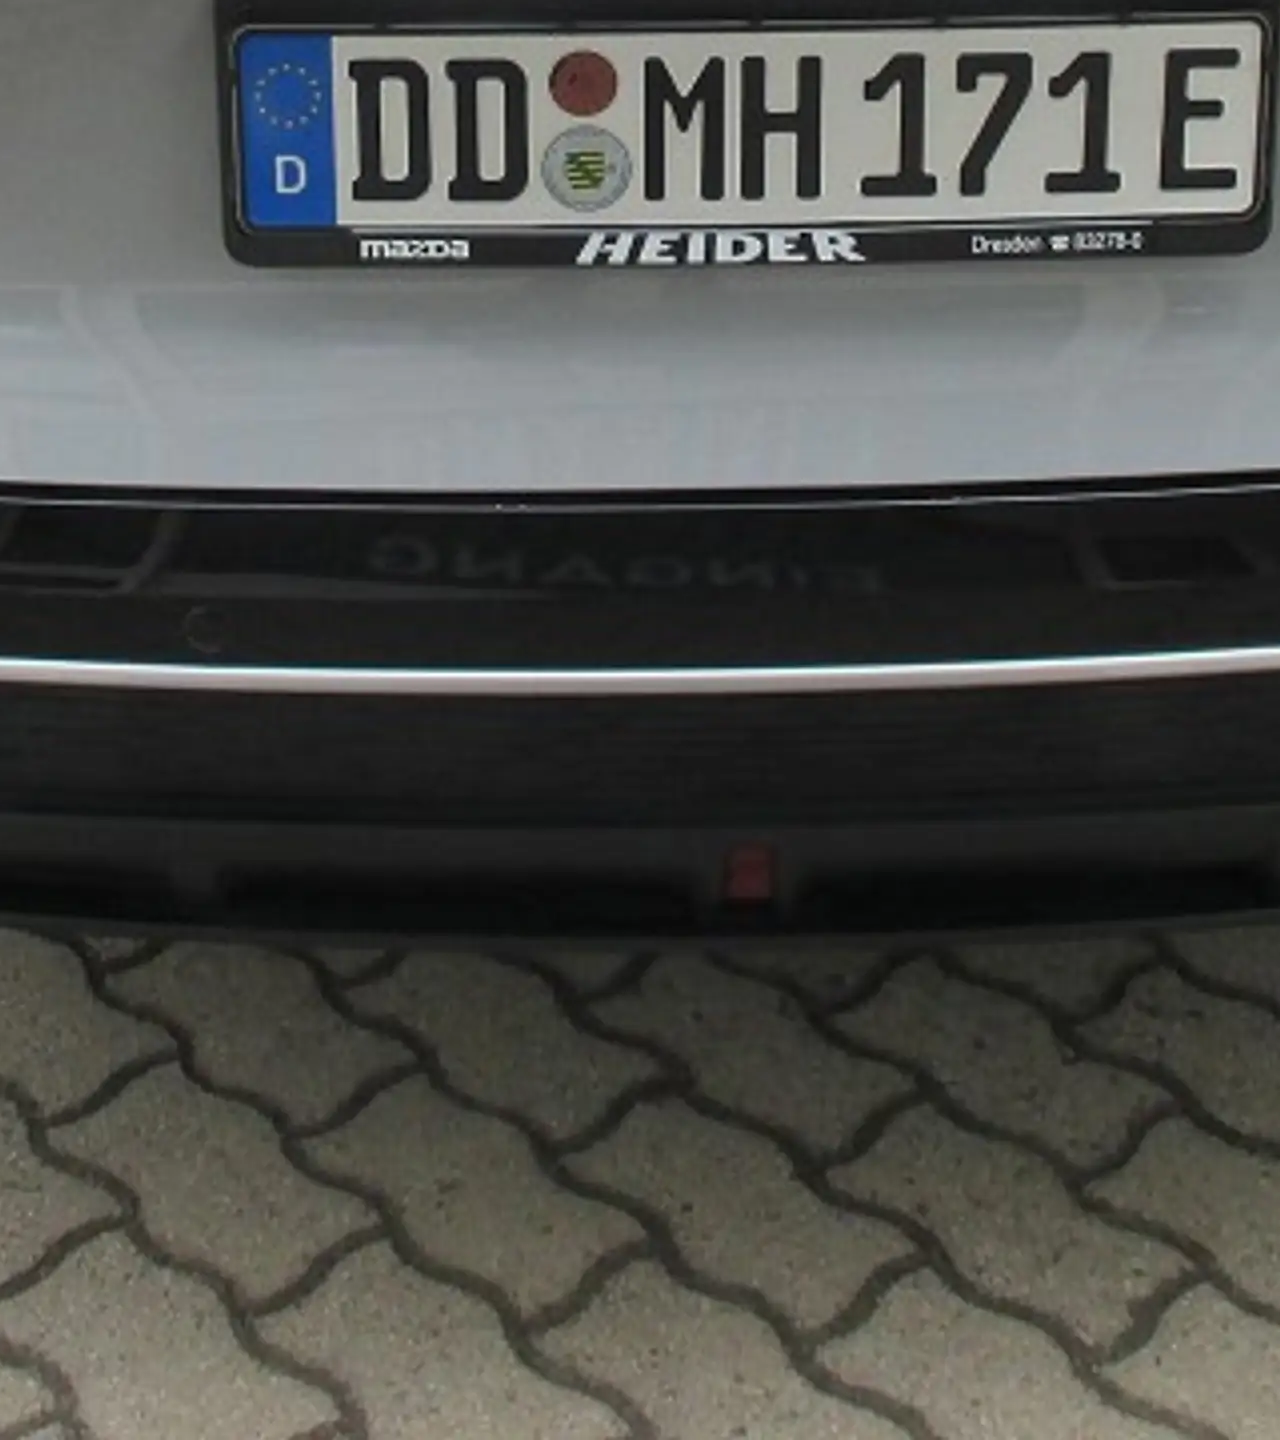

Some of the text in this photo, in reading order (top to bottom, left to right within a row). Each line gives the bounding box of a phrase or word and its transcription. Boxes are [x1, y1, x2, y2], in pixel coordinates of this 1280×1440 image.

[349, 58, 530, 201] DD
[643, 56, 823, 201] MH
[276, 157, 306, 194] D
[360, 239, 470, 258] mazda
[575, 232, 865, 265] HEIDER
[971, 234, 1042, 254] Dresden
